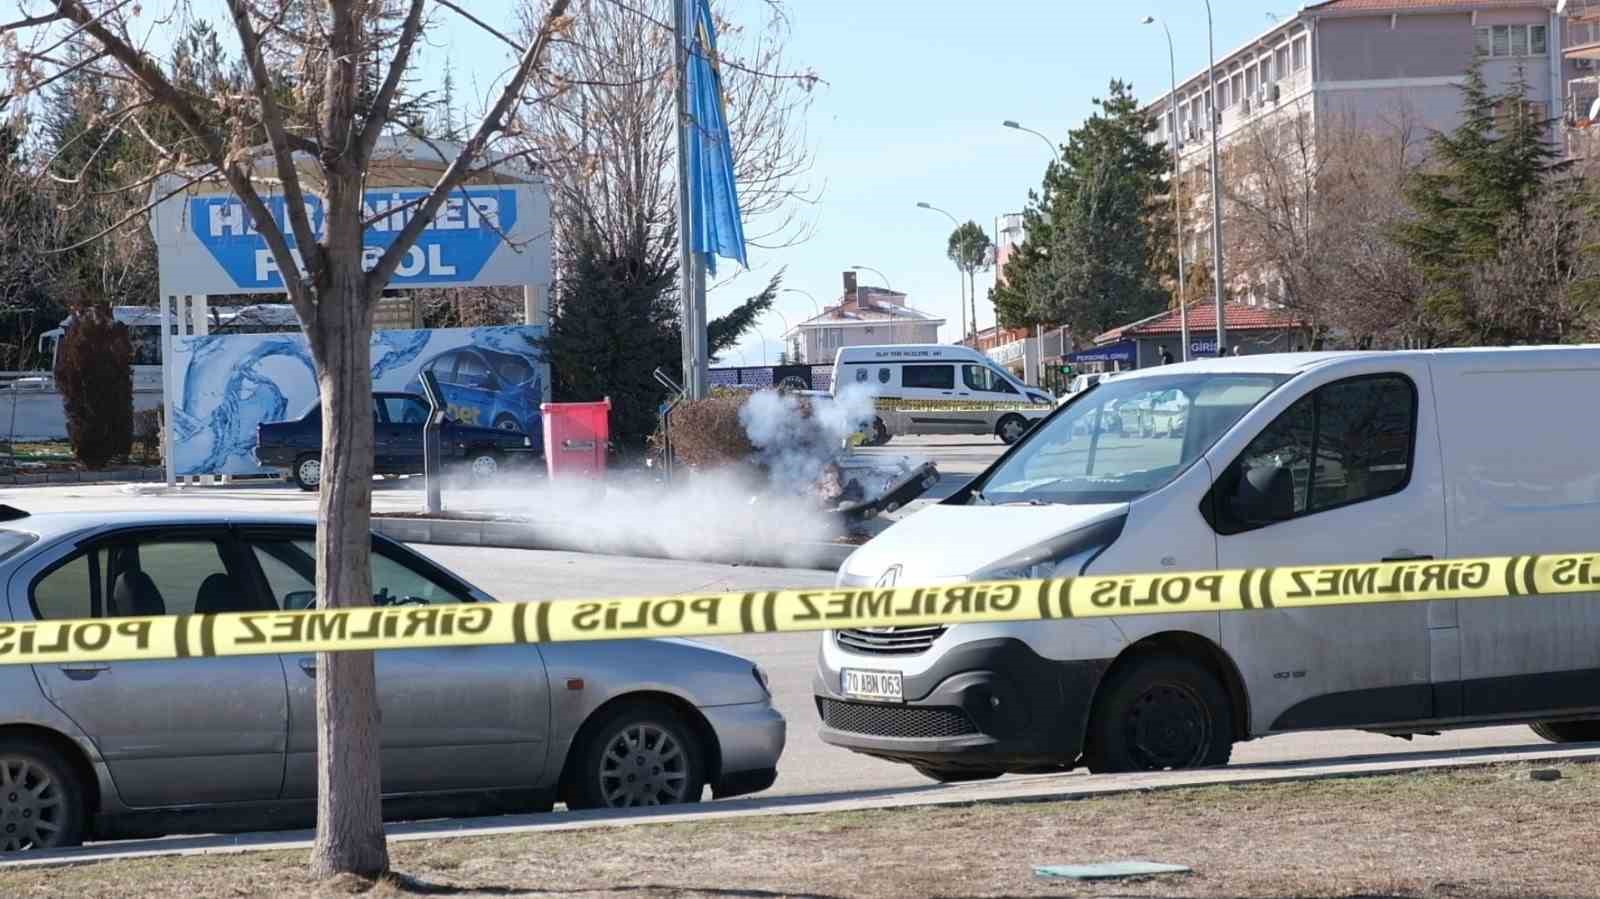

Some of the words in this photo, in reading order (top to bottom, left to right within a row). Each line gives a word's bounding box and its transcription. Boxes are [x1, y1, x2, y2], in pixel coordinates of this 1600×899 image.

[255, 243, 456, 281] PROL
[847, 672, 858, 692] 70
[861, 673, 879, 694] ABN
[881, 675, 901, 695] 063
